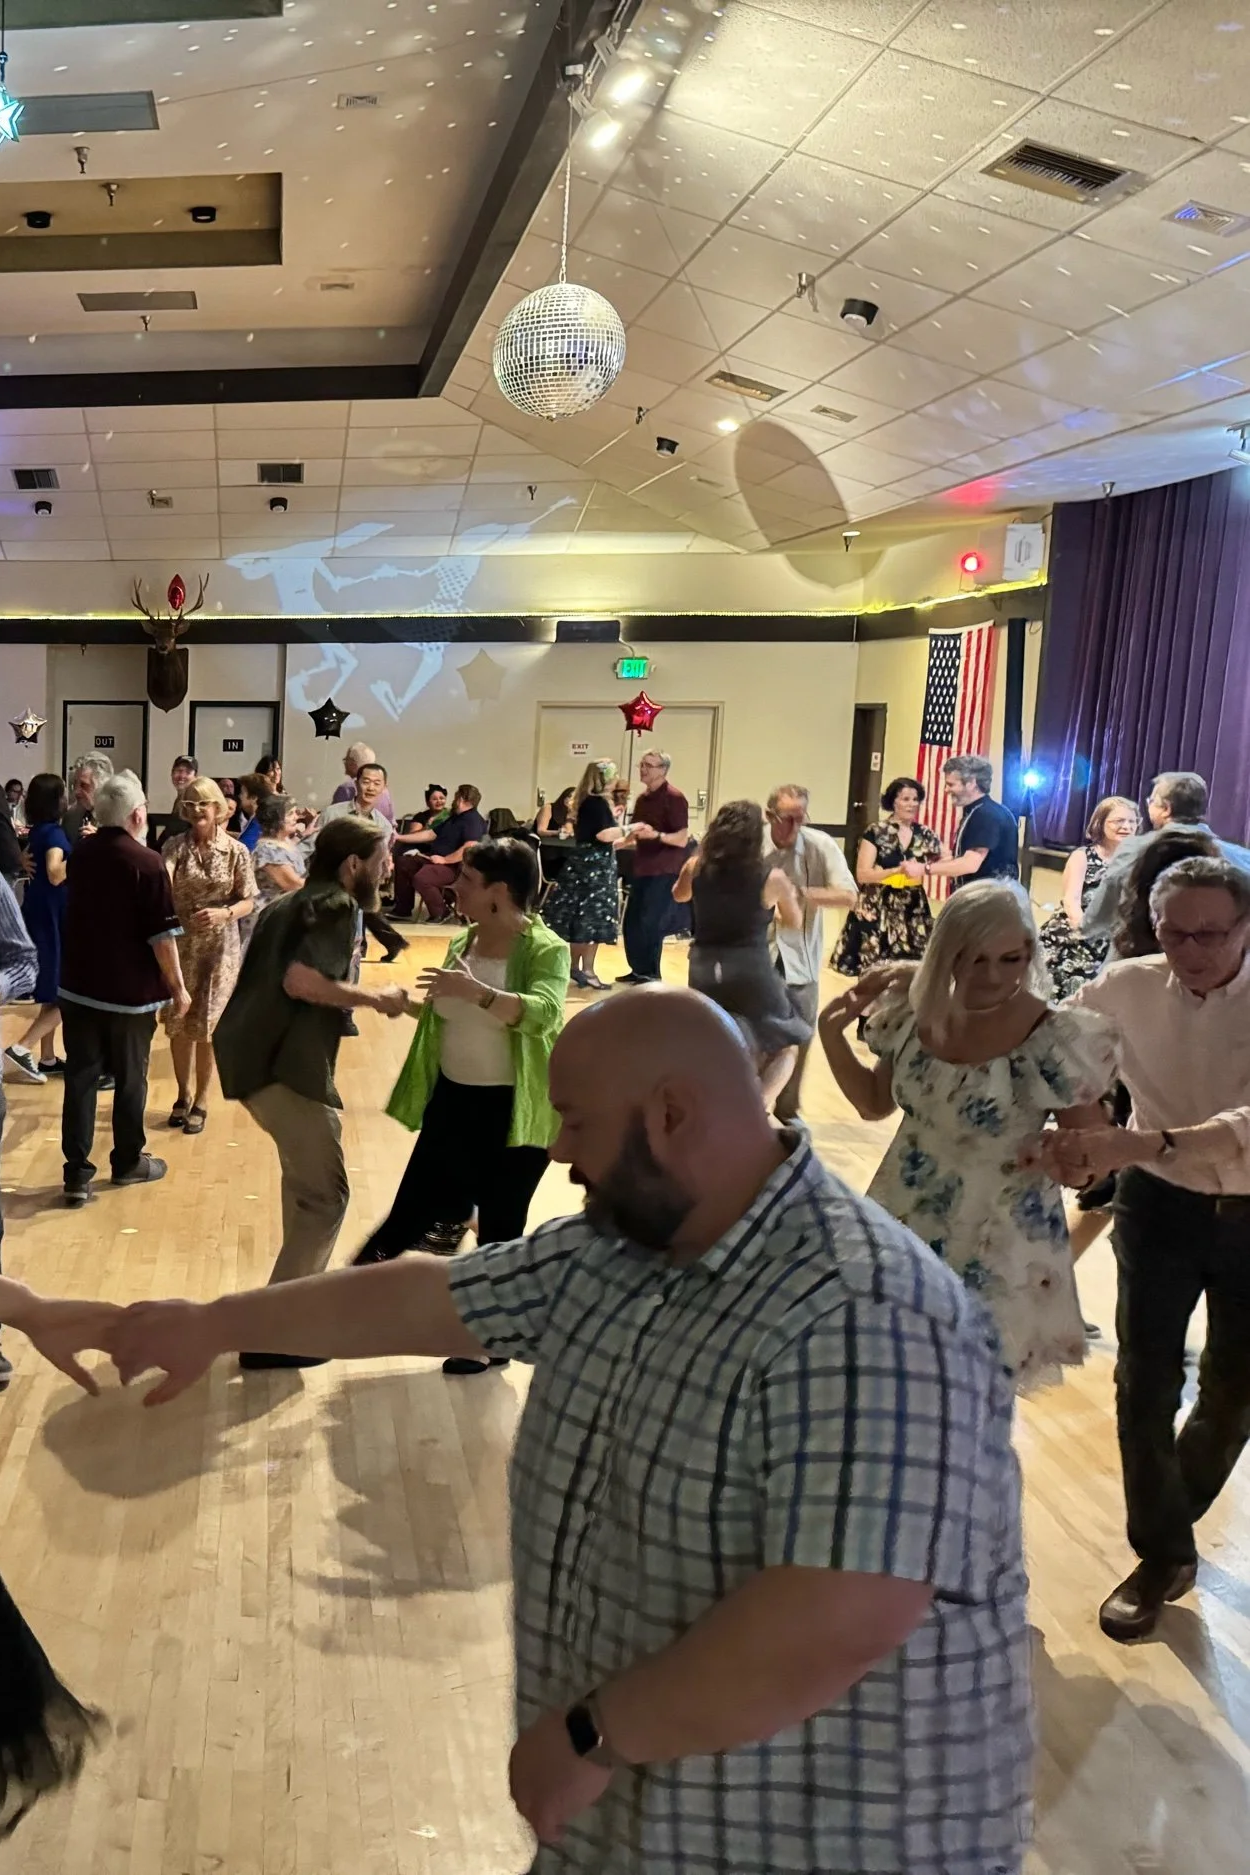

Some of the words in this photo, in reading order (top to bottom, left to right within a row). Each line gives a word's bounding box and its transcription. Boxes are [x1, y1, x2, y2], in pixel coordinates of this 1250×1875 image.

[623, 660, 647, 677] EXIT
[95, 737, 113, 746] OUT
[228, 741, 239, 750] IN
